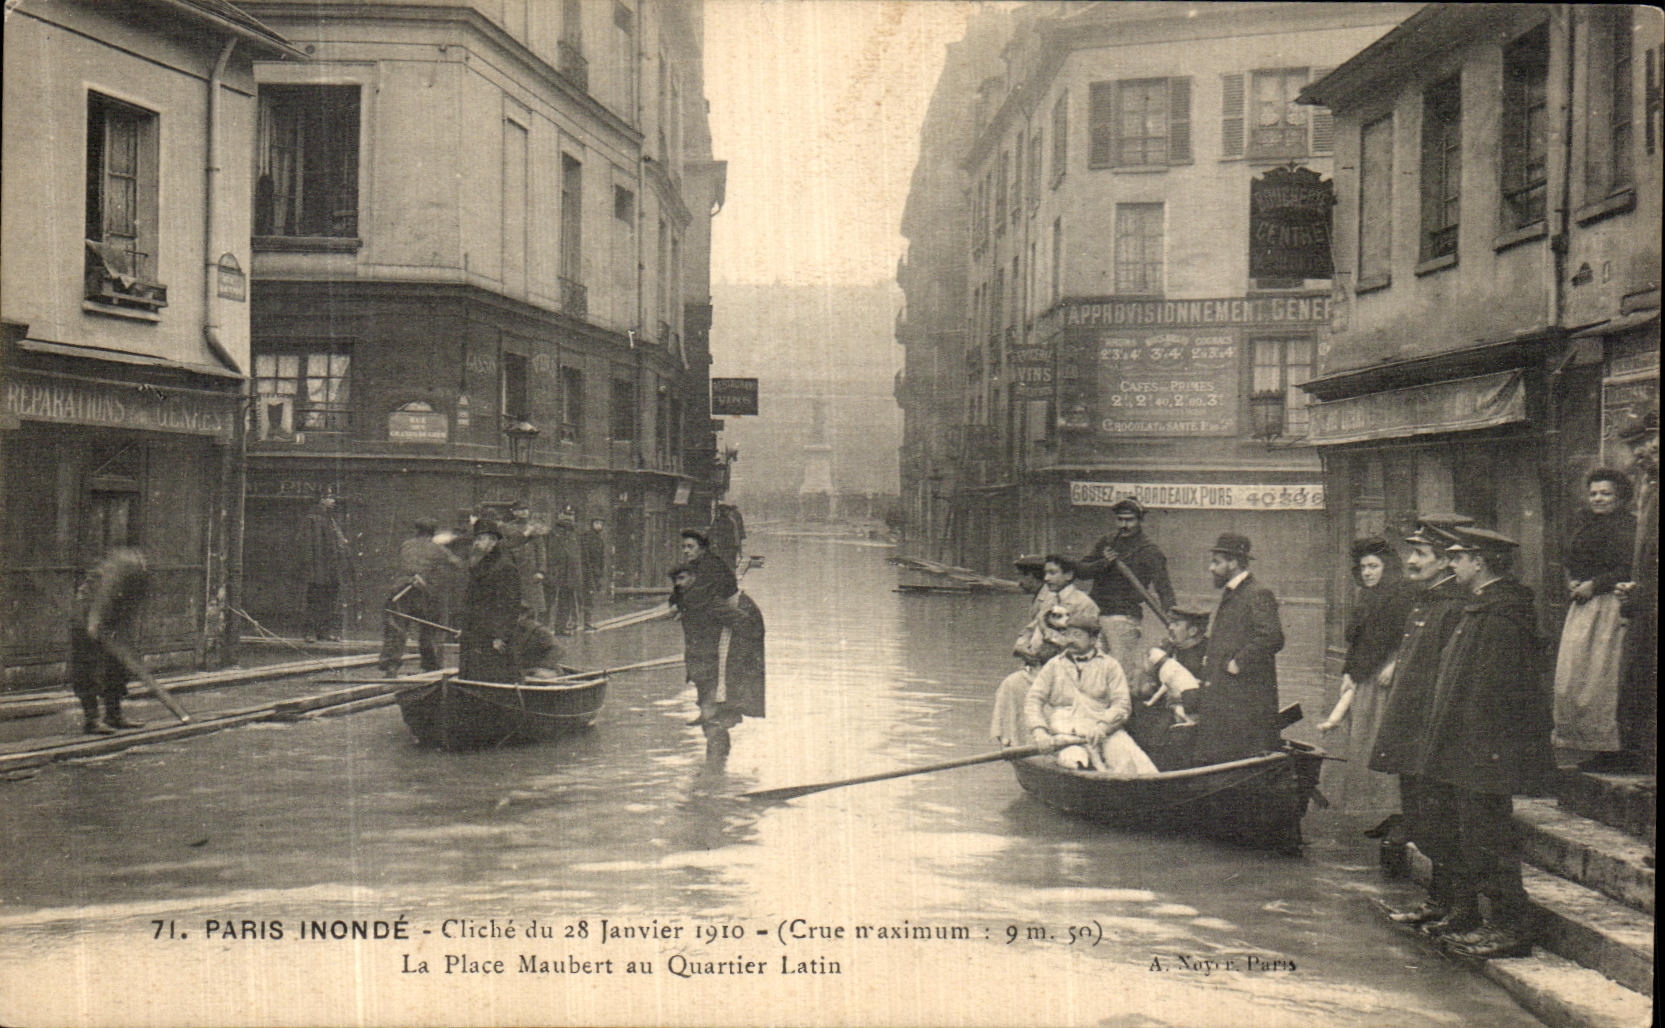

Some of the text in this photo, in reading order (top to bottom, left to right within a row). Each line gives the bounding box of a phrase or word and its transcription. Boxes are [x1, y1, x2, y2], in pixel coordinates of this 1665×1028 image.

[1066, 299, 1264, 326] APPROVISIONNEMENT
[1016, 366, 1052, 382] VINS
[1135, 485, 1197, 505] BORDEAUX
[1199, 487, 1233, 508] PURS
